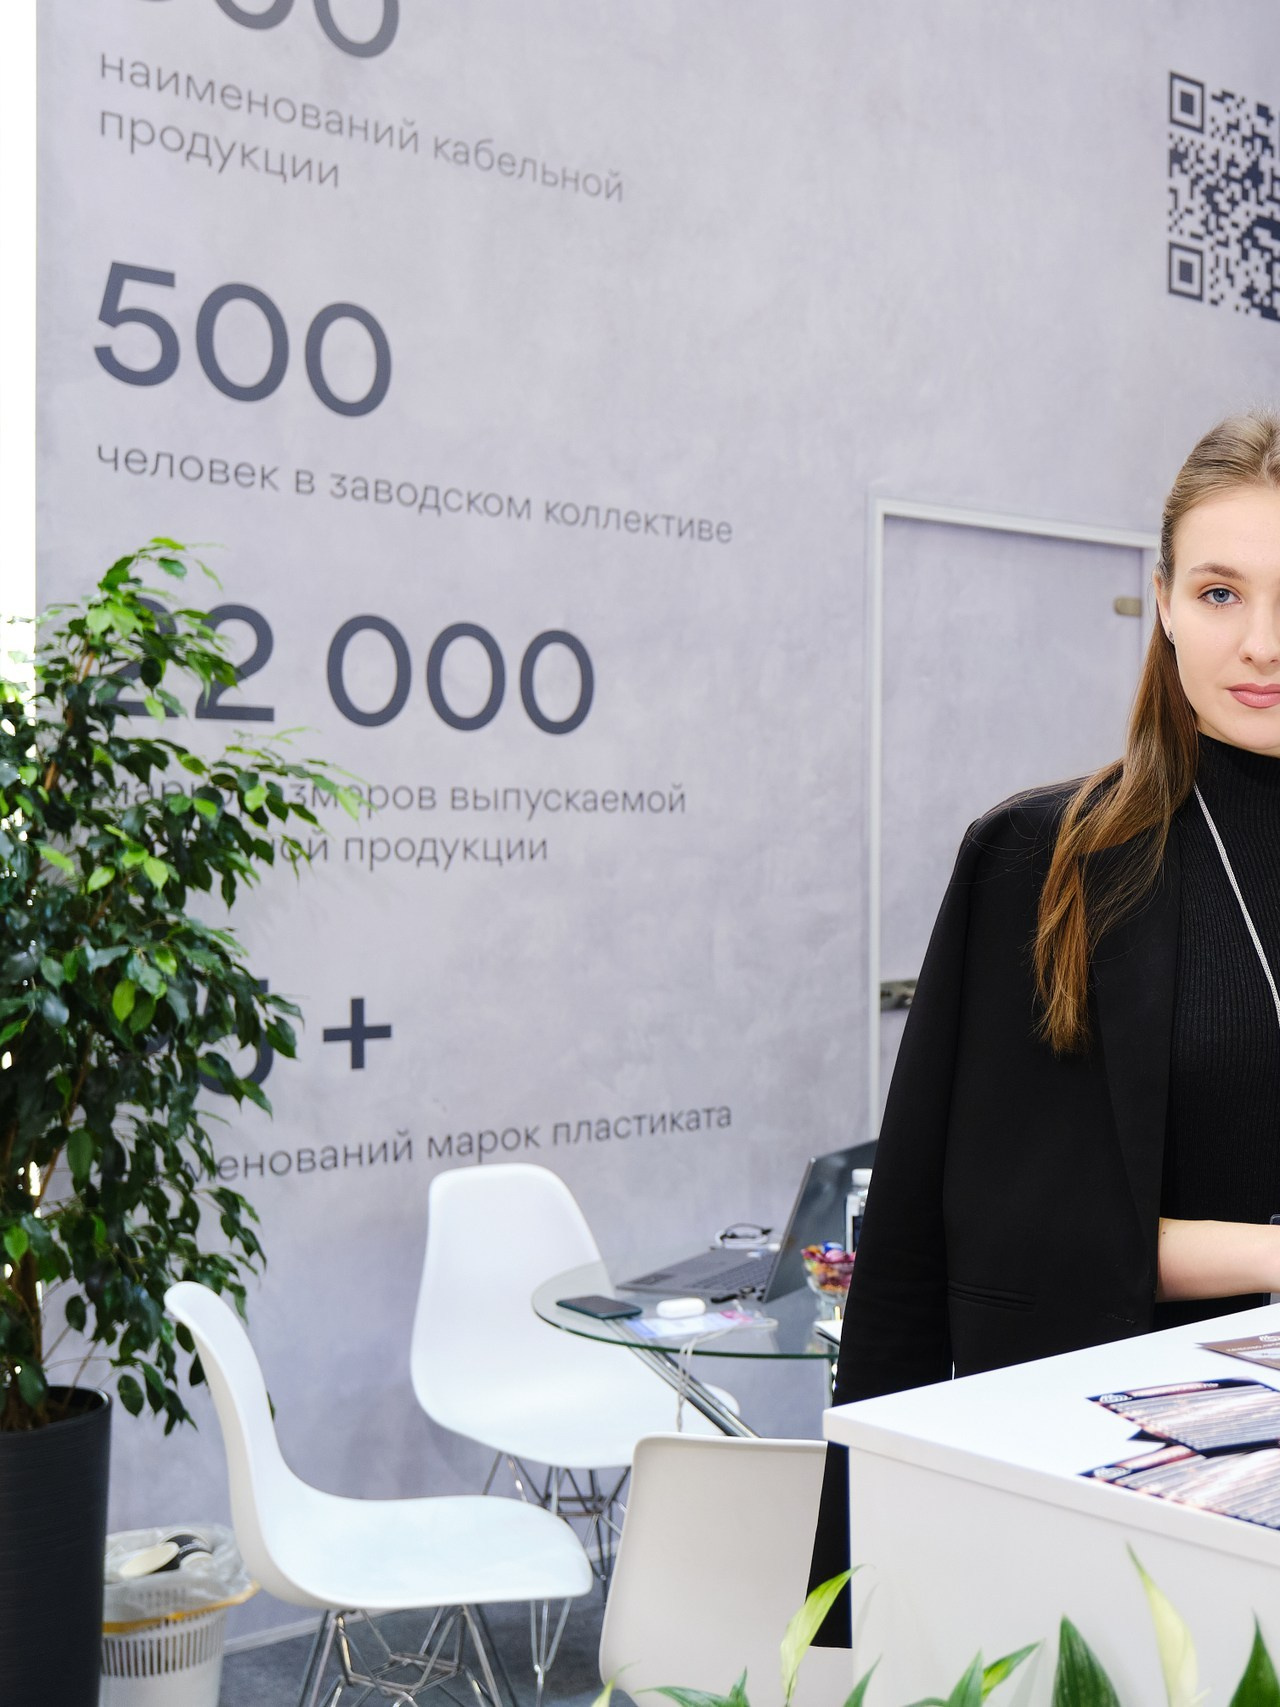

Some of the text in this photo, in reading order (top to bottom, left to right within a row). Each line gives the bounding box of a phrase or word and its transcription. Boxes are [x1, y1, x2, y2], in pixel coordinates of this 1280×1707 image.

[100, 53, 624, 202] наименований кабельной
[100, 109, 340, 189] продукции
[94, 261, 392, 417] 500
[97, 444, 733, 544] человек в заводском коллективе
[326, 614, 594, 735] 000
[451, 783, 687, 821] выпускаемой
[345, 836, 549, 872] продукции
[427, 1124, 540, 1162] марок
[553, 1105, 732, 1148] пластиката
